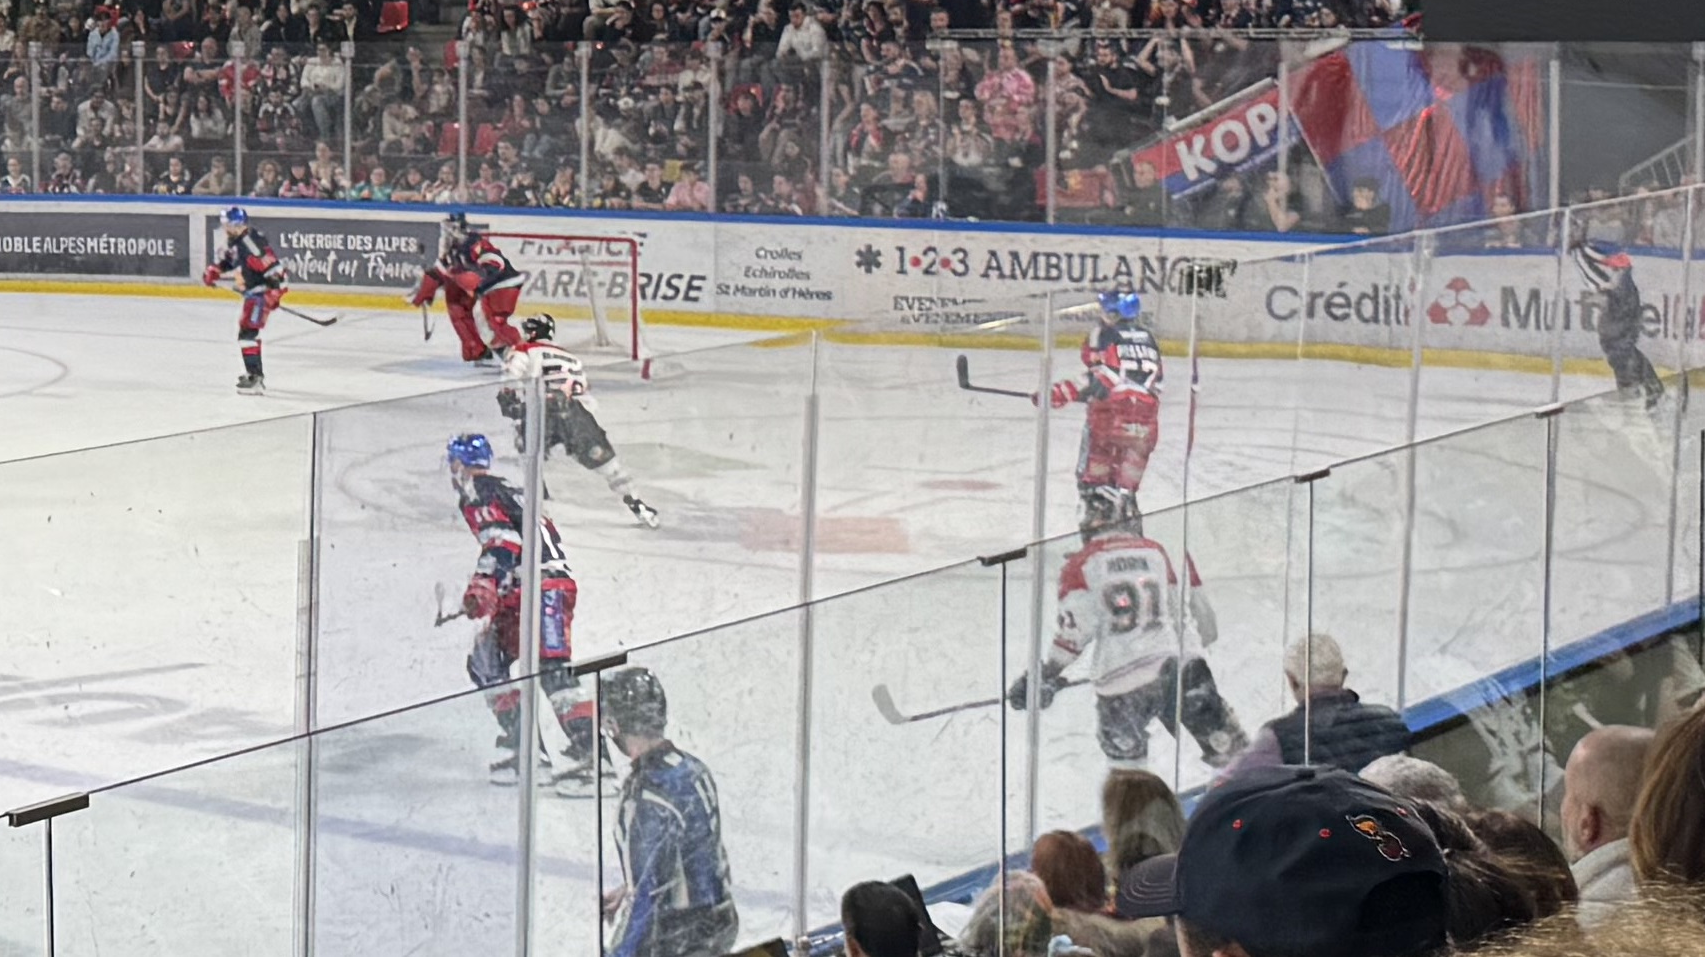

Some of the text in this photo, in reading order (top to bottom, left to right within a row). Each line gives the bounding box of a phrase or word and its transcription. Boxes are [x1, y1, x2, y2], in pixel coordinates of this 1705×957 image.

[1175, 103, 1278, 181] KOP
[347, 235, 372, 251] DES
[375, 236, 418, 252] ALPES
[755, 246, 804, 261] Crolles
[733, 284, 777, 298] Martin
[1104, 577, 1164, 634] 91
